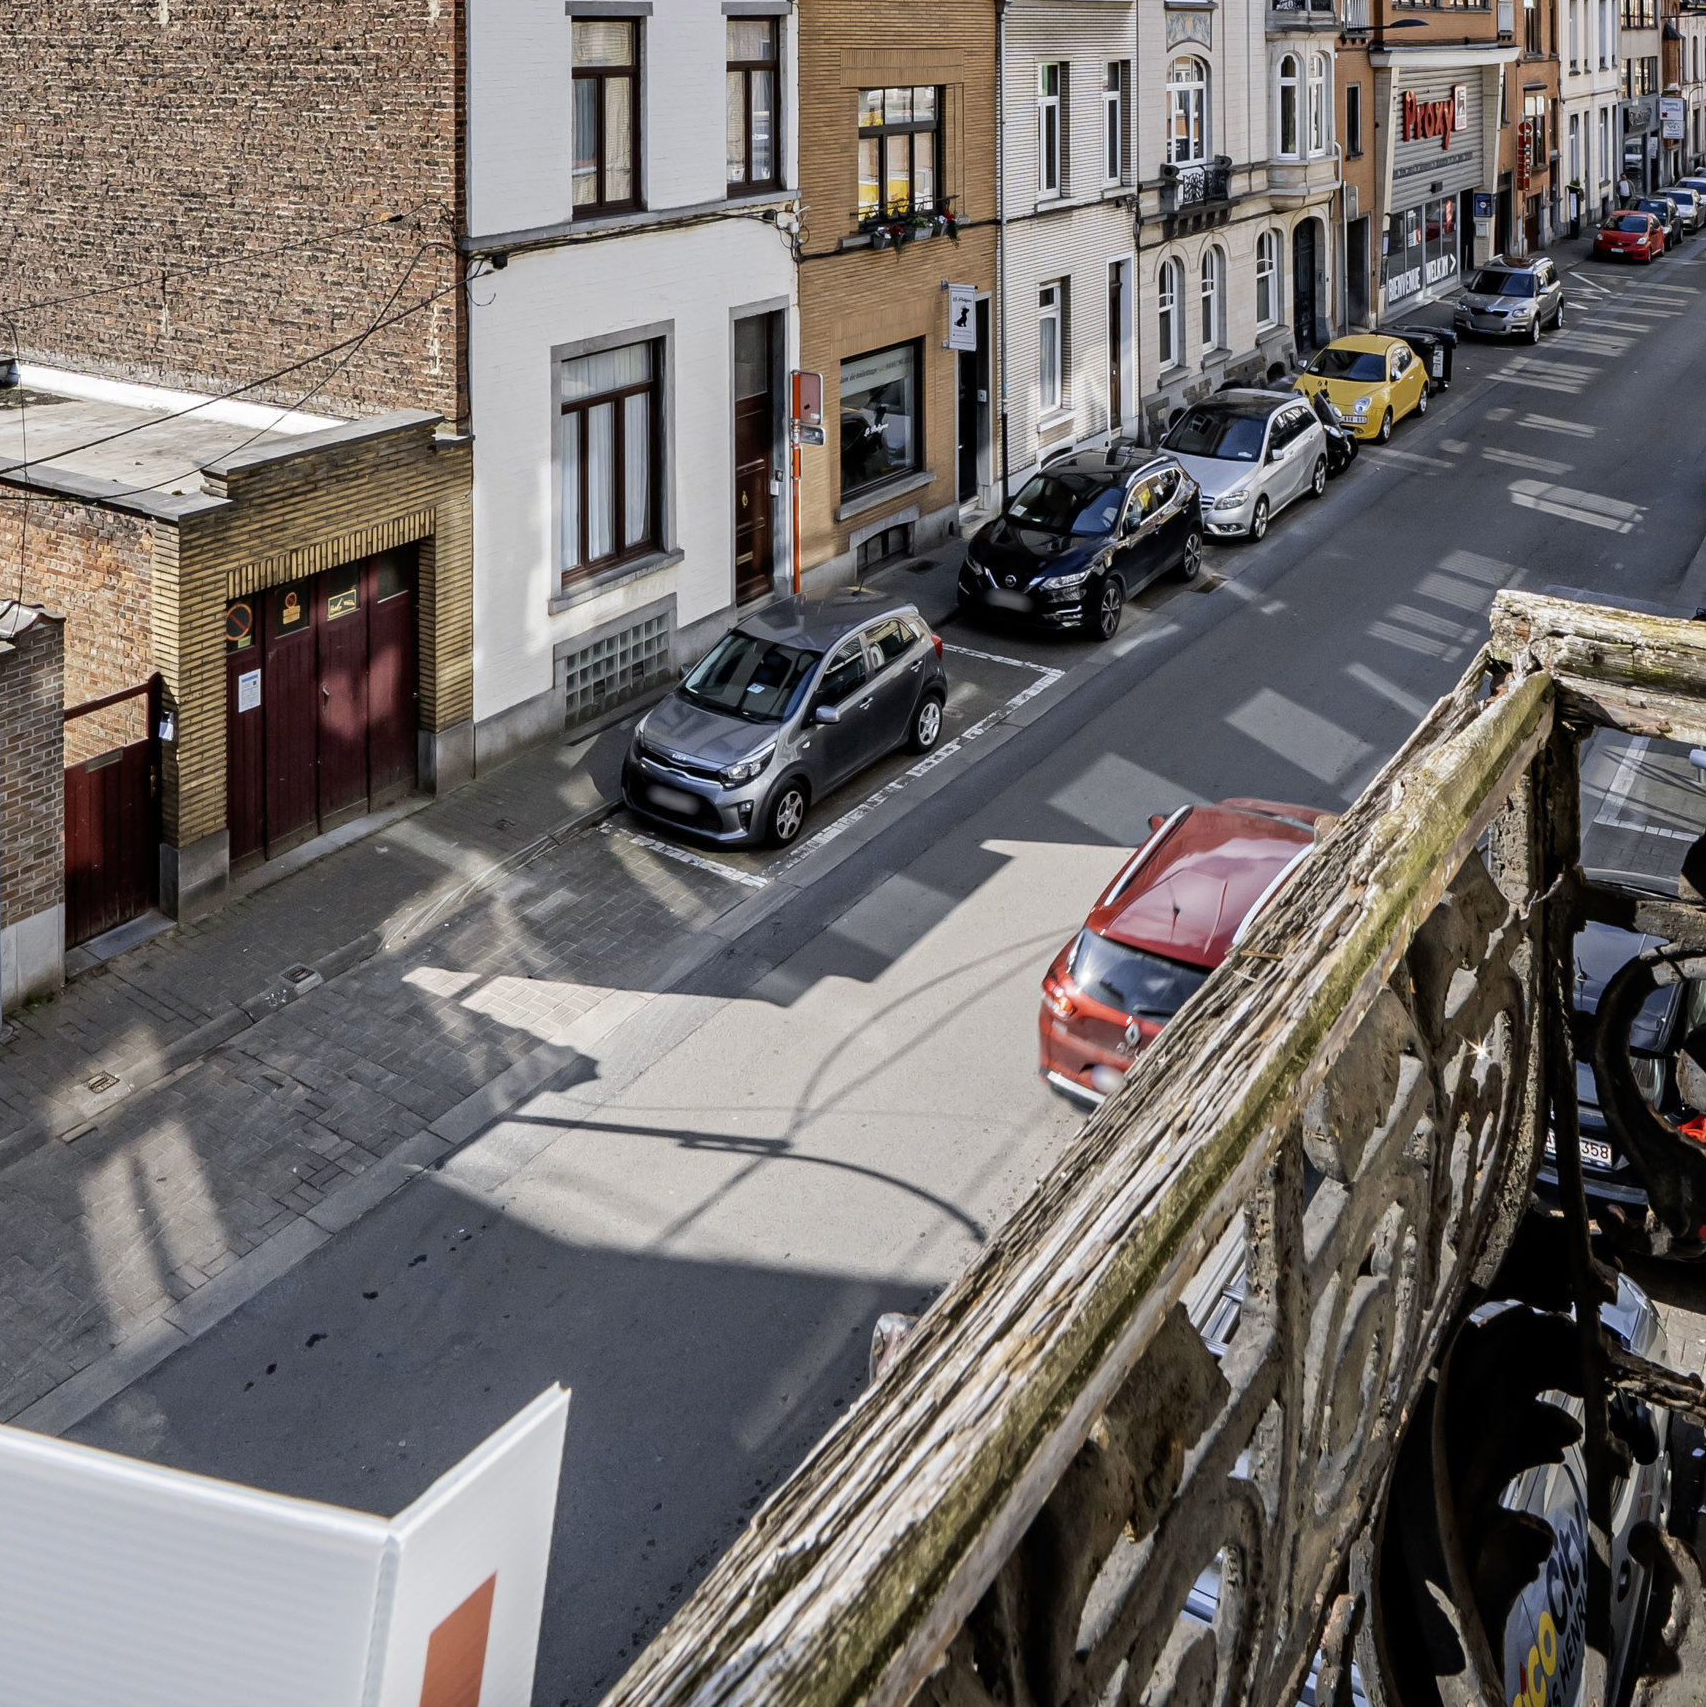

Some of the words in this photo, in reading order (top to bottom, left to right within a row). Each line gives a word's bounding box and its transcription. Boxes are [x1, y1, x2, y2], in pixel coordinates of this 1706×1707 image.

[1403, 90, 1454, 150] Proxy
[1388, 267, 1421, 303] BIENVENUE
[1581, 1140, 1608, 1159] 358
